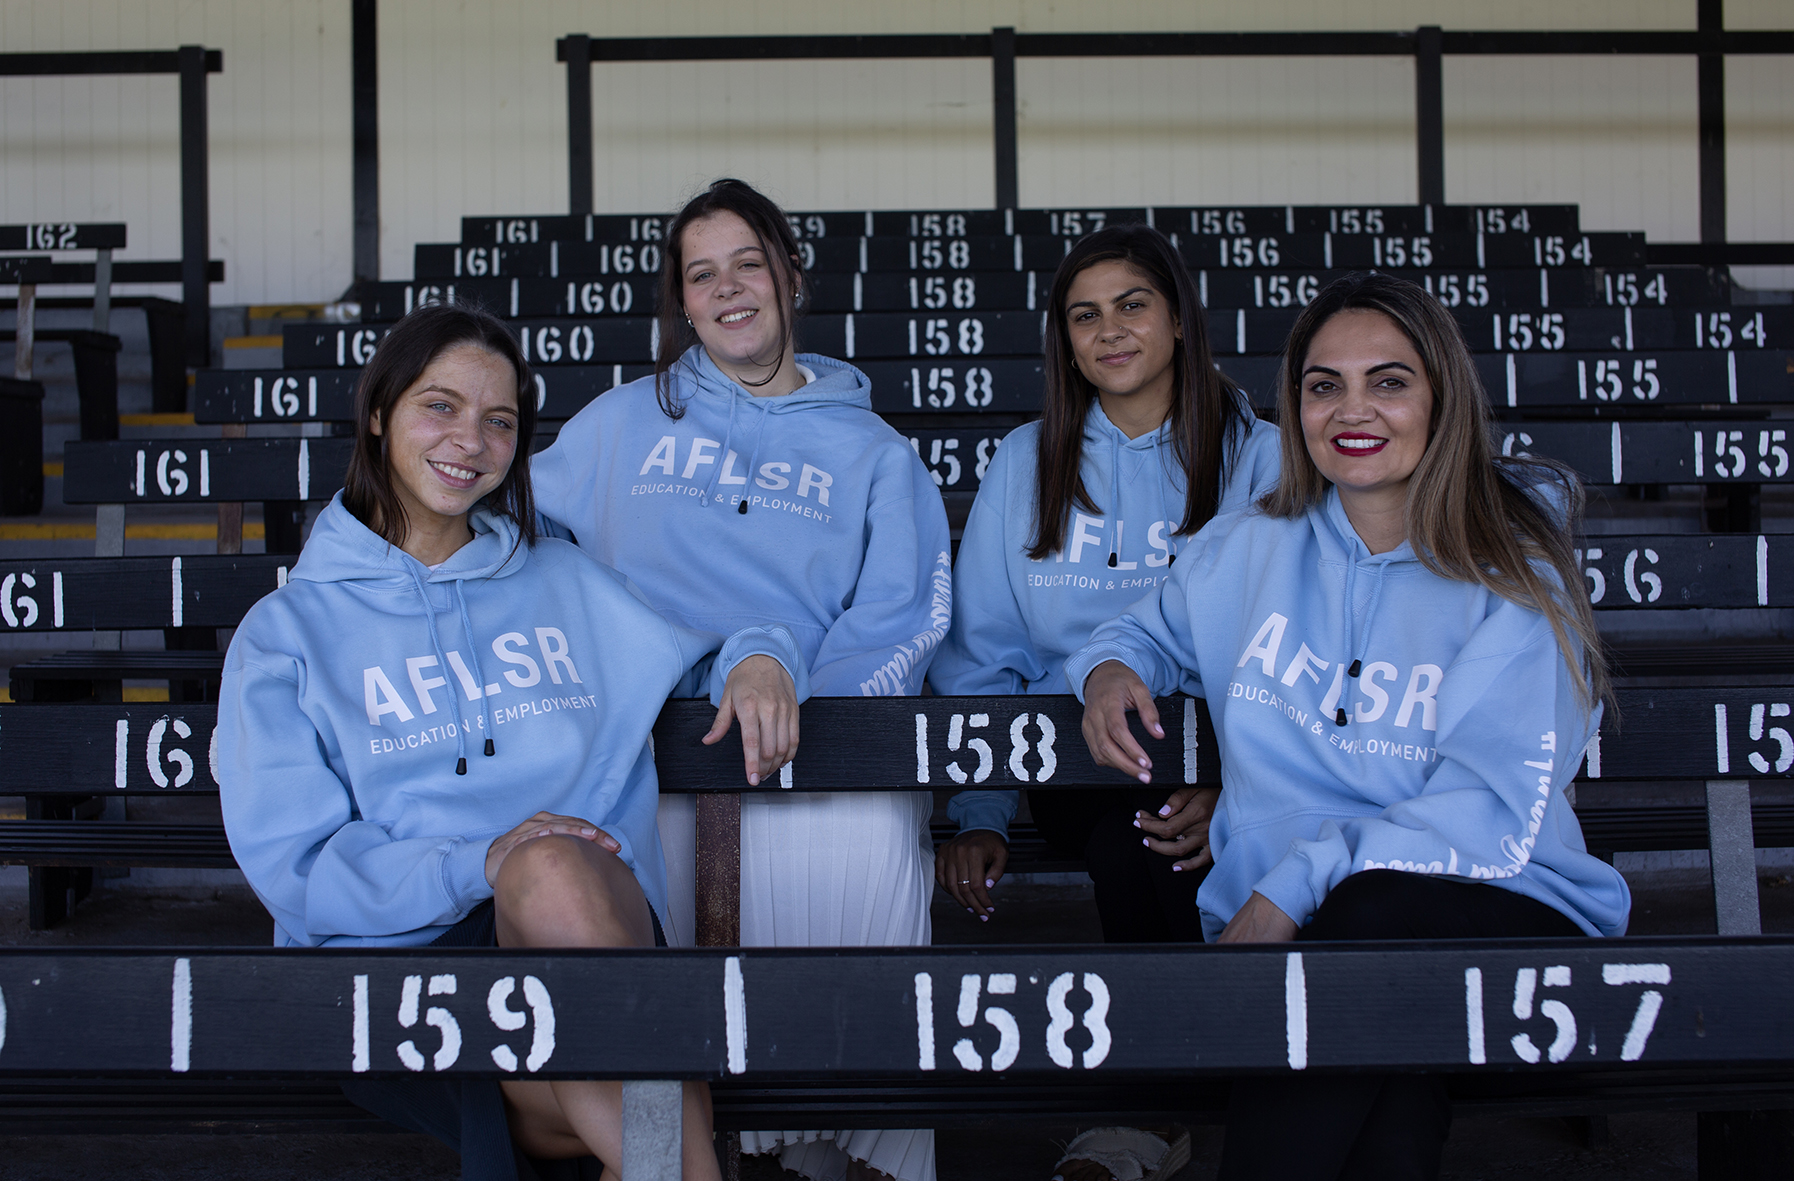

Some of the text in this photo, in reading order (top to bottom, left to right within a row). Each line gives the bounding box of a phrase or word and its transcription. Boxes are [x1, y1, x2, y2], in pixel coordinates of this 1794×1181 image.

[26, 222, 78, 250] 162
[497, 221, 537, 242] 161
[786, 215, 826, 239] 59
[912, 215, 965, 236] 158
[1052, 213, 1104, 234] 157
[1192, 211, 1244, 233] 156
[1332, 210, 1383, 232] 155
[1478, 210, 1529, 232] 154
[455, 248, 499, 276] 161
[601, 245, 659, 273] 160
[910, 241, 969, 268] 158
[1221, 238, 1279, 266] 156
[1375, 238, 1432, 266] 155
[1535, 237, 1591, 264] 154
[567, 282, 632, 313] 160
[910, 277, 975, 308] 158
[1255, 276, 1318, 307] 156
[1426, 275, 1489, 306] 155
[1606, 274, 1667, 304] 154
[337, 330, 391, 366] 16
[521, 326, 594, 361] 160
[909, 318, 984, 354] 158
[1494, 314, 1565, 349] 155
[1696, 313, 1766, 348] 154
[253, 376, 317, 417] 161
[911, 367, 993, 408] 158
[1578, 359, 1660, 401] 155
[638, 435, 834, 508] AFLSR
[1694, 430, 1789, 478] 155
[136, 449, 210, 497] 161
[714, 493, 725, 503] &
[1031, 513, 1193, 571] FLS
[1028, 573, 1100, 591] EDUCATION
[1105, 580, 1116, 590] &
[1575, 548, 1662, 604] 56
[0, 571, 64, 628] 61
[363, 626, 583, 726] AFLSR
[1236, 611, 1444, 732] AFLSR
[370, 694, 598, 755] EDUCATION & EMPLOYMENT
[1227, 681, 1437, 763] EDUCATION & EMPLOYMENT
[1714, 703, 1794, 774] 15
[115, 719, 219, 789] 16
[915, 712, 1058, 785] 158
[352, 973, 556, 1073] 159
[914, 972, 1112, 1072] 158
[1465, 963, 1672, 1065] 157
